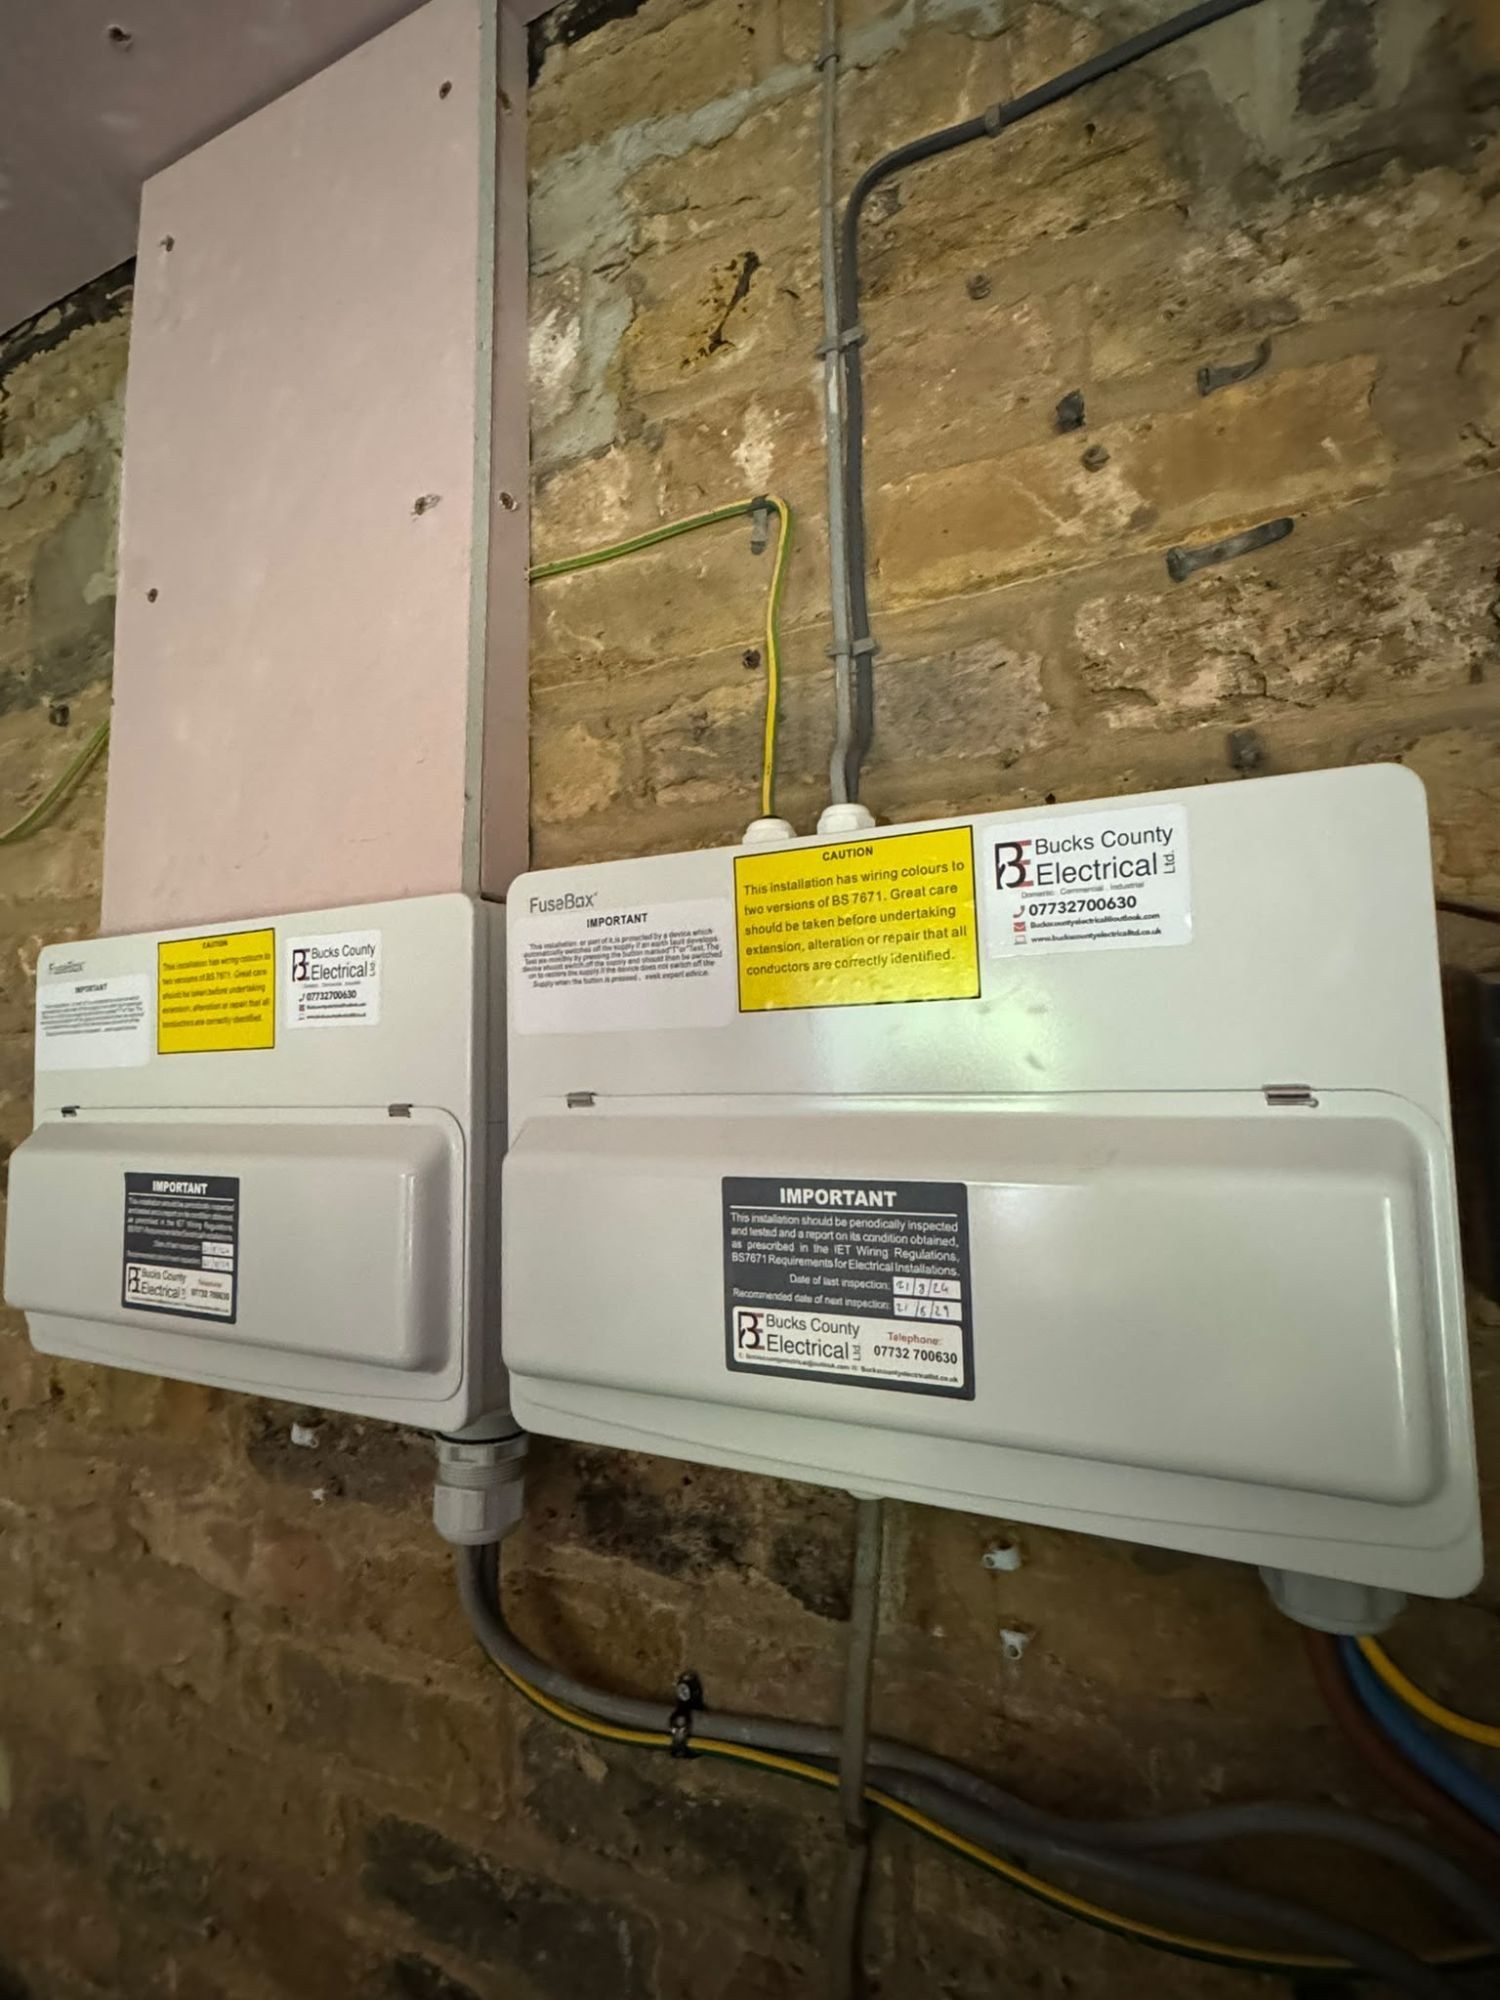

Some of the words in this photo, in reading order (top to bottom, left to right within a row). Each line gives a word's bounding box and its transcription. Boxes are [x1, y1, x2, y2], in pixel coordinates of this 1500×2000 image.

[1035, 835, 1095, 855] Bucks
[1101, 826, 1173, 846] County
[822, 846, 873, 862] CAUTION
[745, 884, 768, 896] This
[770, 877, 833, 893] installation
[836, 874, 858, 885] has
[861, 869, 898, 882] wiring
[901, 863, 949, 878] colours
[952, 860, 965, 872] to
[1036, 852, 1158, 886] Electrical
[529, 893, 595, 914] FuseBox
[744, 905, 764, 916] two
[766, 900, 815, 913] versions
[818, 895, 830, 908] of
[832, 894, 849, 907] BS
[852, 890, 887, 904] 7671.
[890, 886, 926, 900] Great
[929, 884, 958, 896] care
[1028, 895, 1137, 916] 07732700630
[587, 913, 648, 928] IMPORTANT
[745, 921, 783, 936] should
[785, 921, 800, 932] be
[802, 918, 835, 930] taken
[837, 913, 877, 927] before
[880, 906, 957, 923] undertaking
[745, 941, 805, 956] extension,
[807, 936, 864, 951] alteration
[867, 935, 880, 945] or
[883, 931, 921, 945] repair
[923, 927, 948, 940] that
[951, 925, 967, 938] all
[311, 947, 340, 959] Bucks
[342, 944, 376, 958] County
[311, 961, 368, 980] Electrical
[746, 962, 810, 976] conductors
[812, 960, 832, 971] are
[834, 954, 888, 969] correctly
[890, 948, 955, 964] identified.
[152, 1180, 208, 1194] IMPORTANT
[779, 1187, 897, 1208] IMPORTANT
[731, 1211, 750, 1223] This
[751, 1214, 800, 1225] installation
[801, 1215, 833, 1227] should
[835, 1216, 848, 1227] be
[849, 1218, 905, 1231] periodically
[907, 1220, 959, 1233] inspected
[731, 1226, 748, 1236] and
[749, 1227, 777, 1237] tested
[779, 1228, 796, 1239] and
[798, 1230, 804, 1239] a
[805, 1231, 834, 1242] report
[835, 1232, 848, 1241] on
[849, 1232, 860, 1242] its
[862, 1233, 908, 1244] condition
[731, 1240, 742, 1249] as
[747, 1241, 795, 1255] prescribed
[800, 1243, 809, 1253] in
[813, 1244, 829, 1254] the
[834, 1245, 851, 1255] IET
[856, 1246, 889, 1260] Wiring
[768, 1254, 834, 1268] Requirements
[834, 1257, 847, 1269] for
[848, 1259, 894, 1272] Electrical
[141, 1268, 161, 1280] Bucks
[162, 1270, 186, 1284] County
[789, 1273, 810, 1285] Date
[812, 1275, 822, 1285] of
[823, 1277, 839, 1286] last
[141, 1282, 180, 1299] Electrical
[733, 1287, 793, 1302] Recommended
[794, 1294, 813, 1303] date
[814, 1294, 823, 1304] of
[824, 1297, 843, 1306] next
[766, 1313, 807, 1331] Bucks
[810, 1317, 860, 1339] County
[766, 1334, 849, 1360] Electrical
[873, 1345, 910, 1359] 07732
[912, 1349, 958, 1364] 700630
